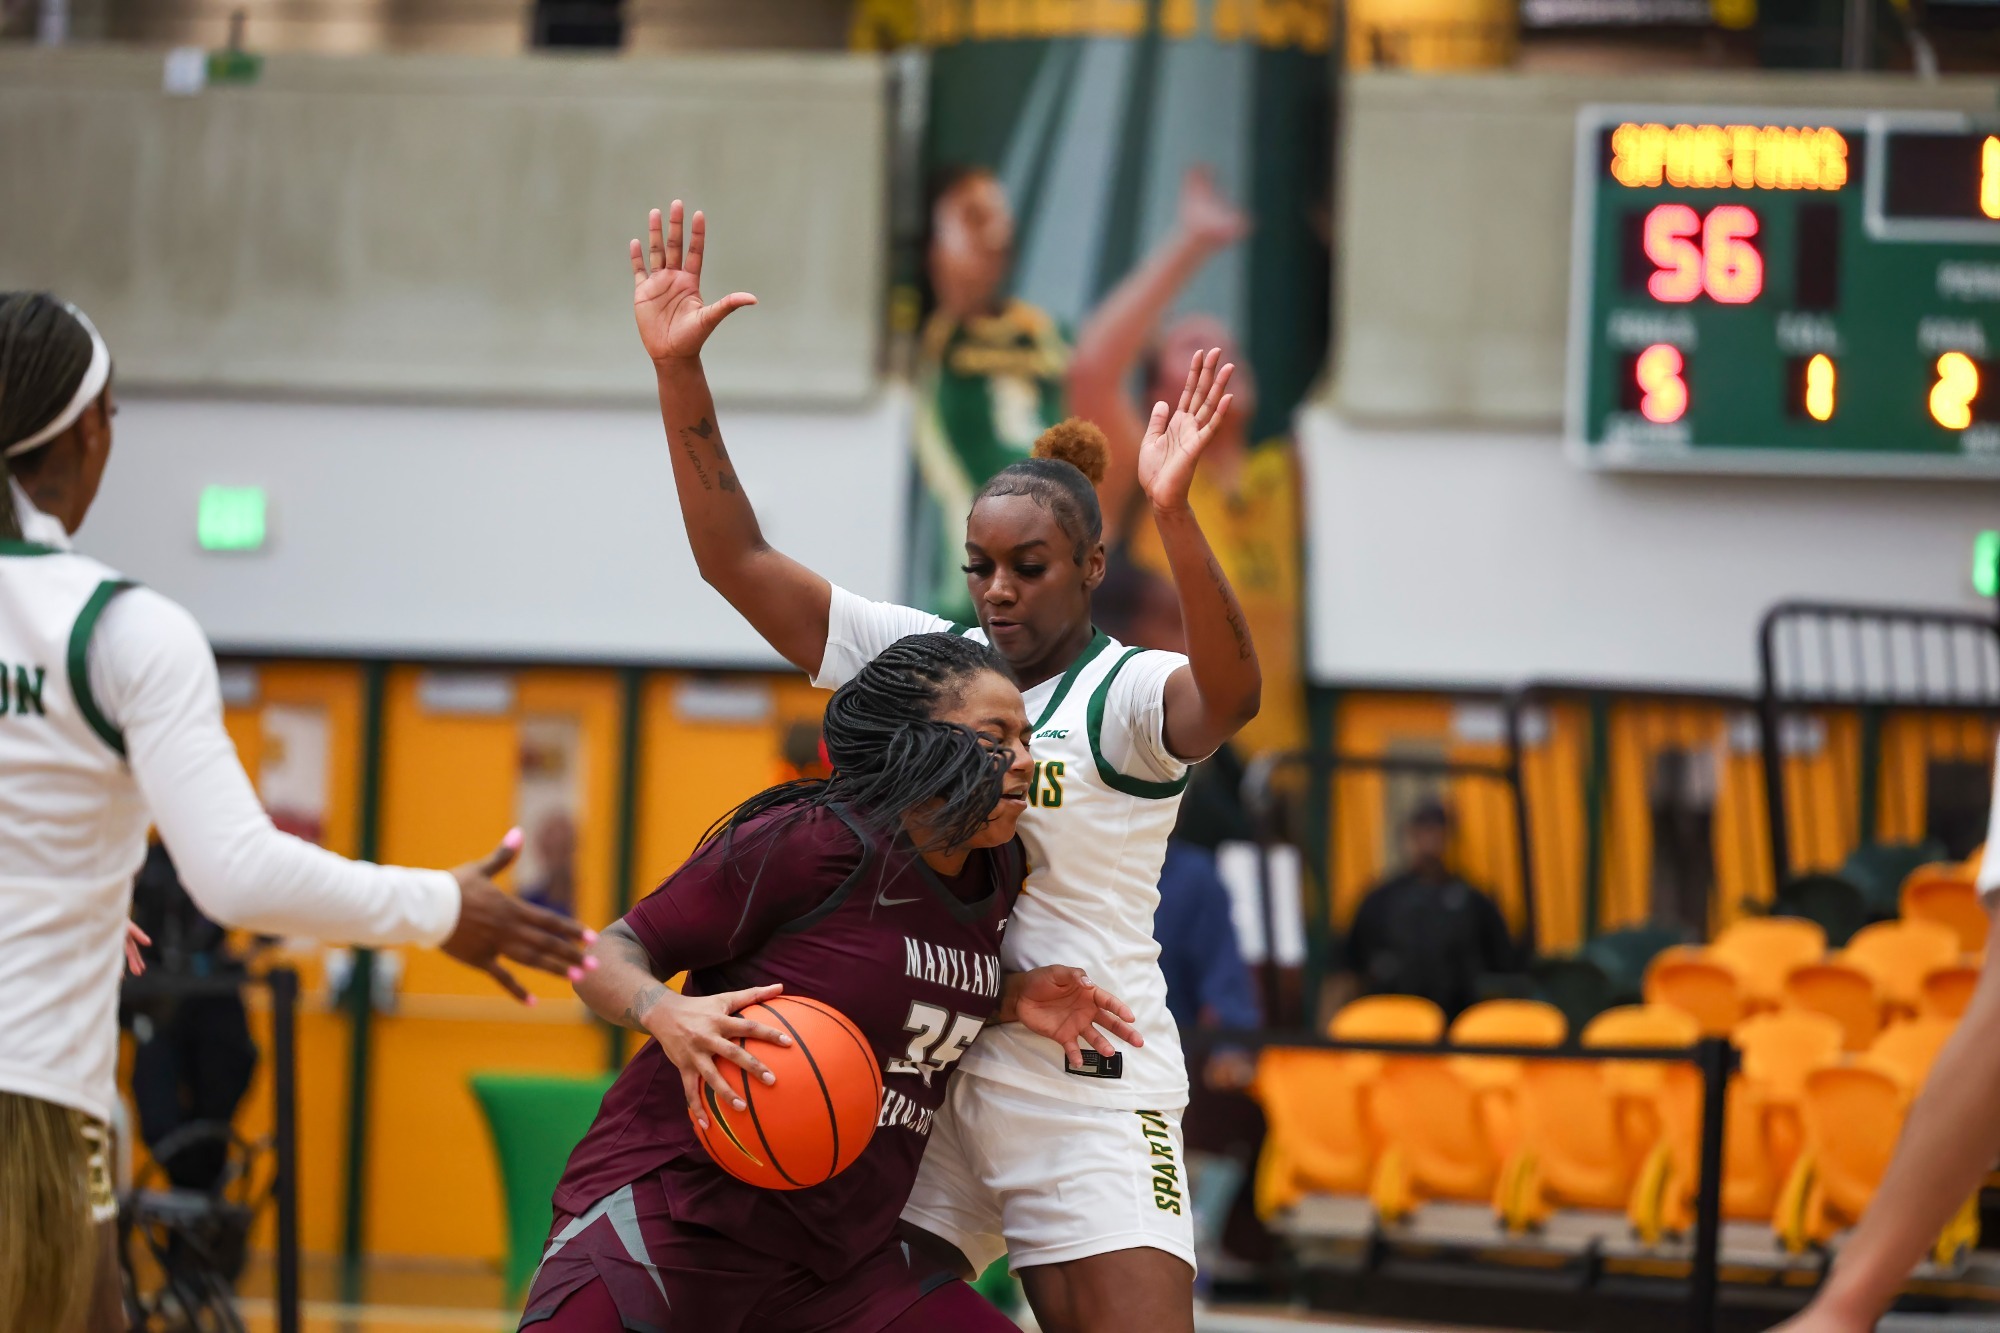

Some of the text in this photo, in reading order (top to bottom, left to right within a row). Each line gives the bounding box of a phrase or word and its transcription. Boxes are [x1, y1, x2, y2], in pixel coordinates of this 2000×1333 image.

[1643, 204, 1764, 304] 56
[1806, 353, 1835, 421] 1
[1929, 351, 1979, 430] 2
[877, 1086, 917, 1127] ERN
